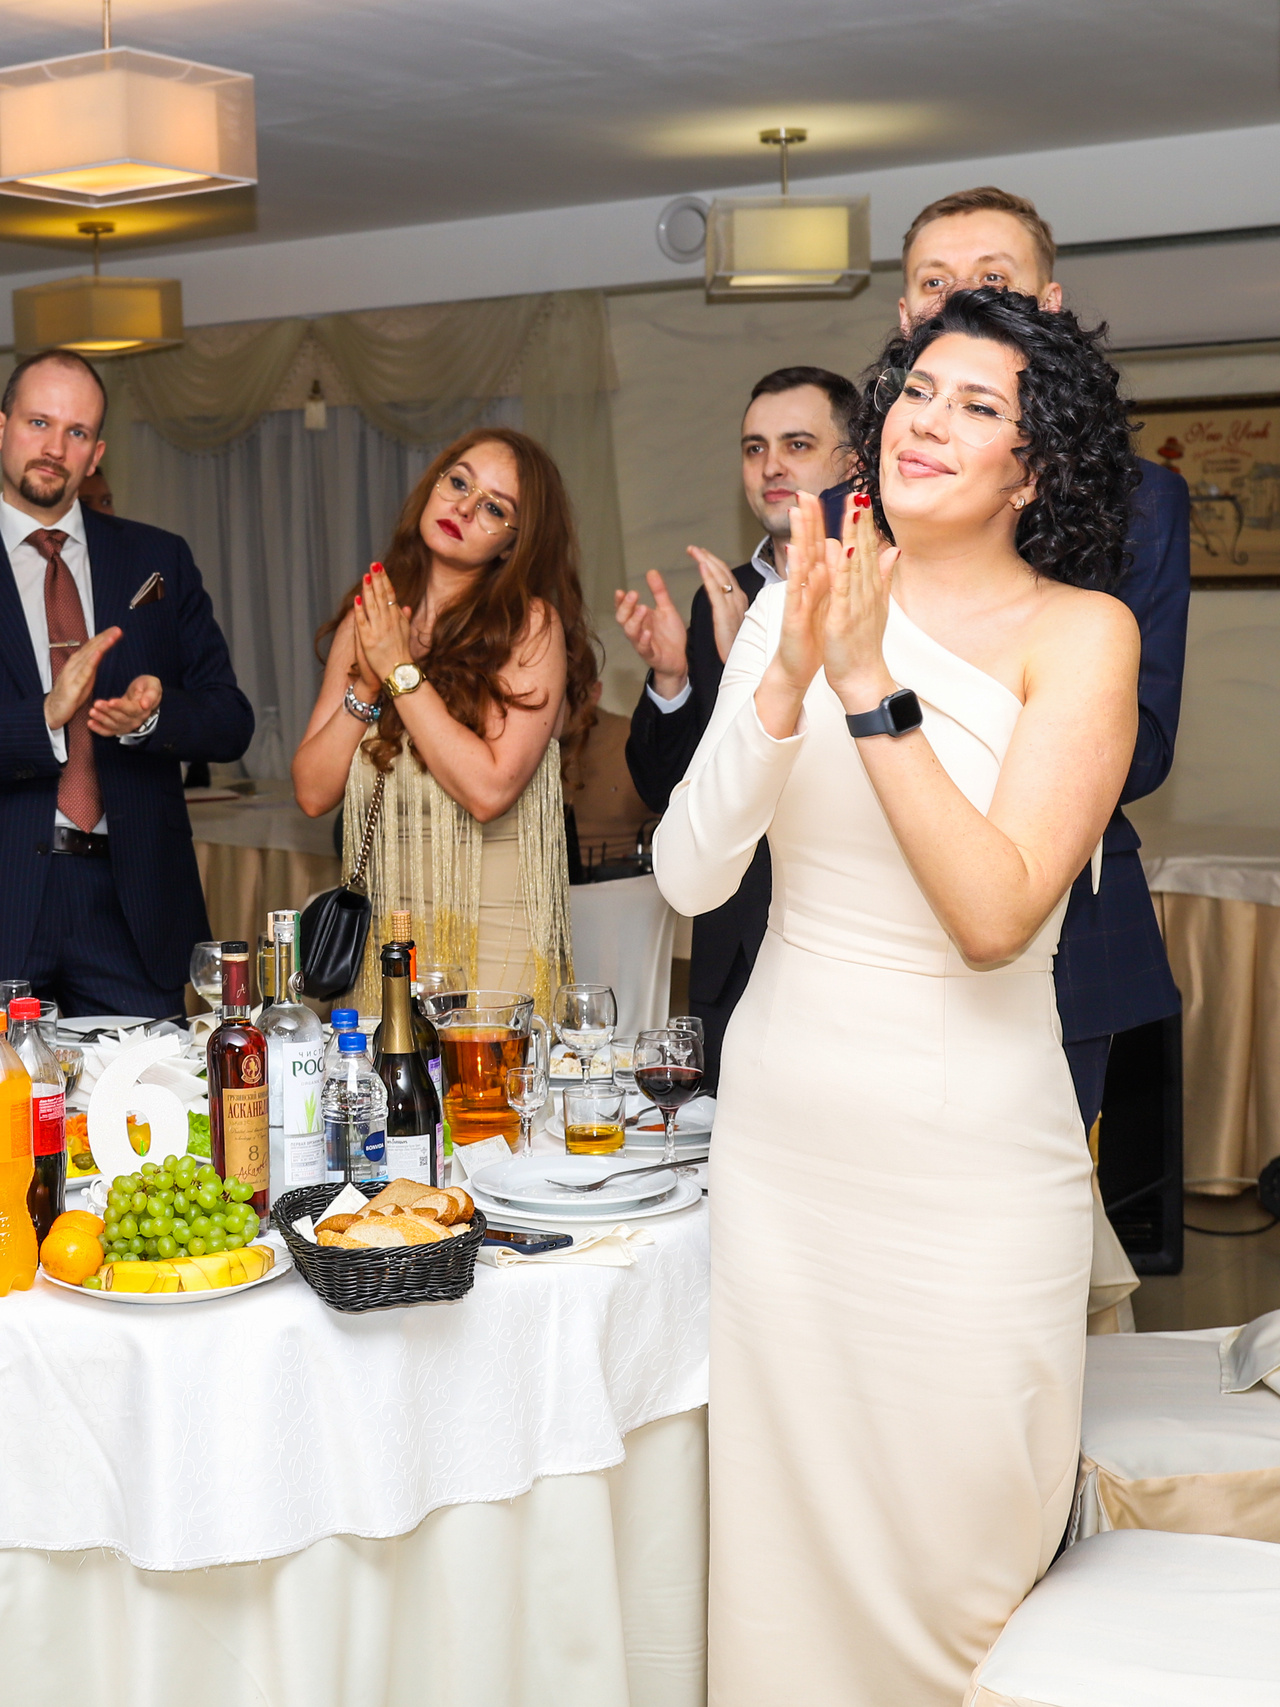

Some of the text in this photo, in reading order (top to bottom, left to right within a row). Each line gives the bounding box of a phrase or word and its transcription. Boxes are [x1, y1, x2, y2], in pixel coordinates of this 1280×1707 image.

[298, 1047, 324, 1058] ЧИСТ
[291, 1056, 324, 1078] РОС
[86, 1034, 189, 1186] 6
[248, 1144, 260, 1162] 8
